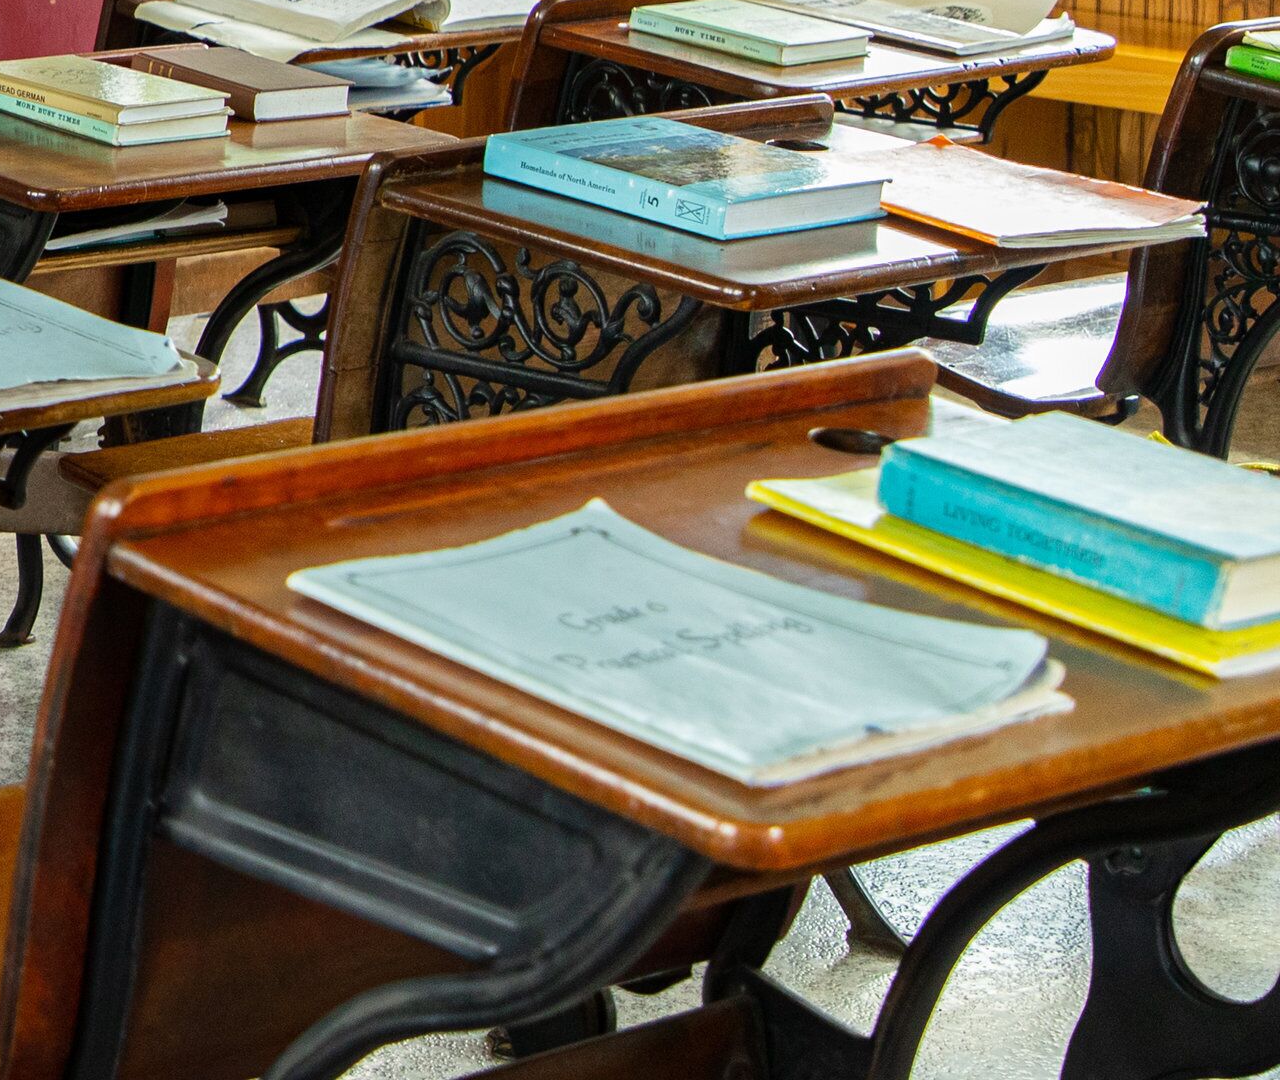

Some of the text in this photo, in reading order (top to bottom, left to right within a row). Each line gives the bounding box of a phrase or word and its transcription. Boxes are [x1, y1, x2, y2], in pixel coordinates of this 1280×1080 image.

[16, 90, 46, 103] GERMAN
[15, 99, 36, 112] MORE
[57, 113, 81, 126] TIMES
[520, 160, 616, 195] Homelands of North America
[648, 195, 659, 207] 5
